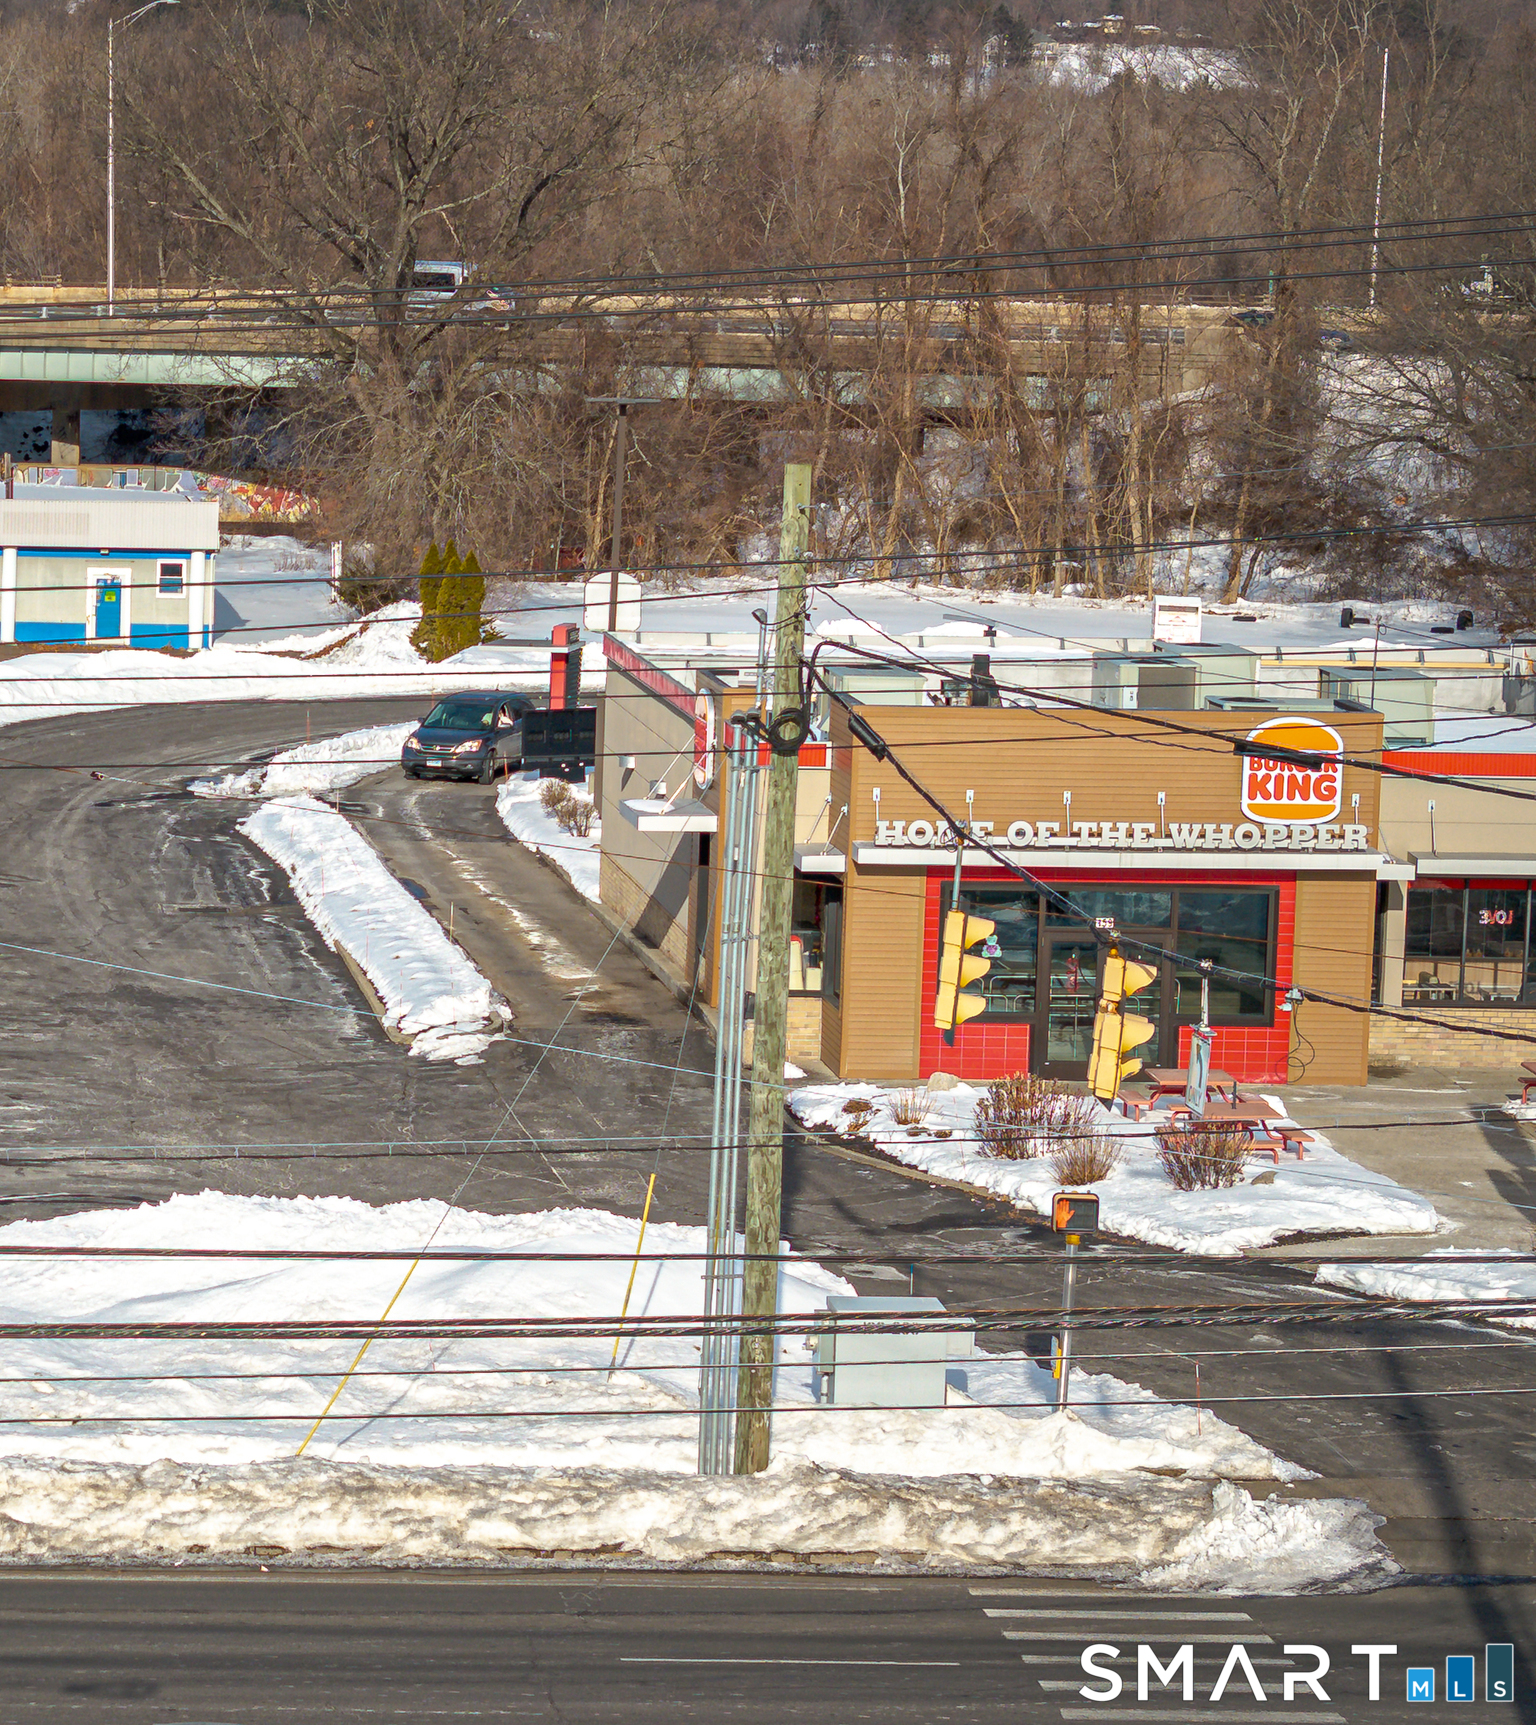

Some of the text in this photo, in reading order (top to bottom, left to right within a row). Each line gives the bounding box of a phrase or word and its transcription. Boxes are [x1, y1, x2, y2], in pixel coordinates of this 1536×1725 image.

[1249, 754, 1339, 773] BURR
[1248, 773, 1337, 801] KING
[1007, 820, 1060, 847] OF
[1073, 821, 1156, 849] THE
[1169, 823, 1368, 850] WHOPPER
